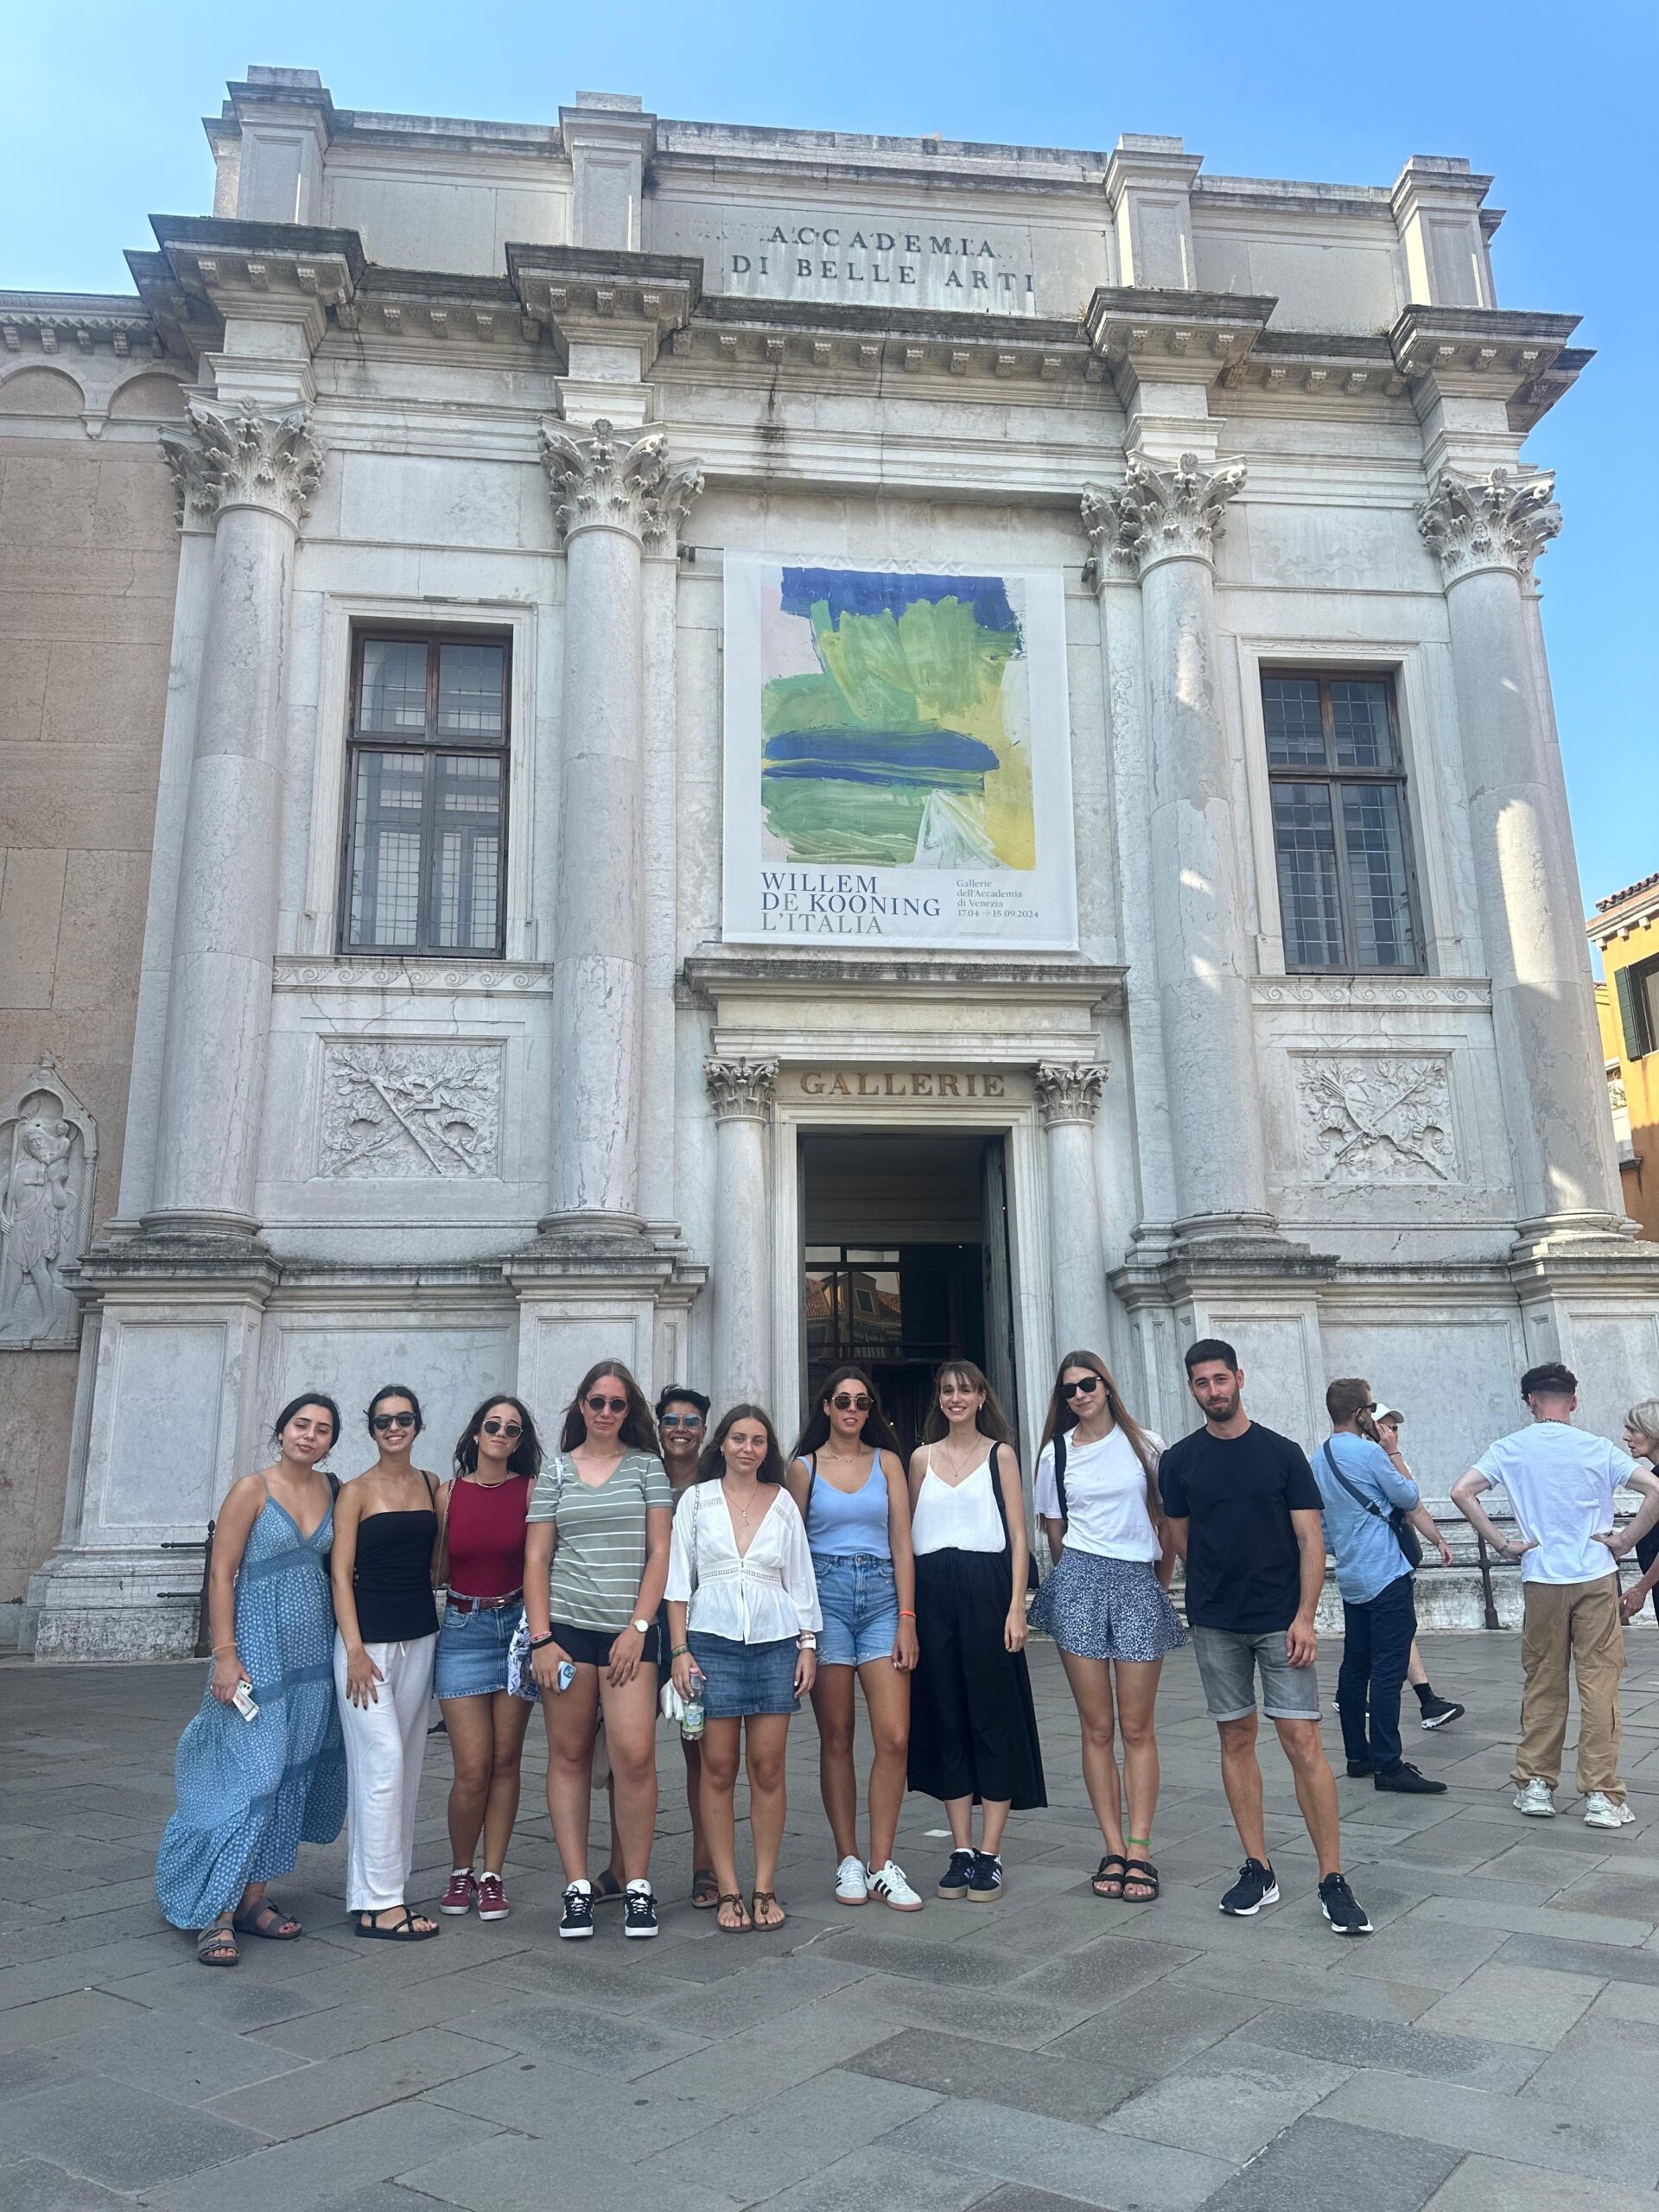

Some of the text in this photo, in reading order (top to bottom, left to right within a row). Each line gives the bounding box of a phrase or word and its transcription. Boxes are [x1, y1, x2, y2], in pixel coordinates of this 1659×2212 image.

[770, 226, 994, 257] ACCADEMIA
[732, 254, 1033, 291] DI BELLE ARTI
[761, 872, 878, 893] WILLEM
[957, 879, 992, 887] Gallerie
[762, 893, 940, 917] DE KOONING
[800, 1071, 1005, 1097] GALLERIE
